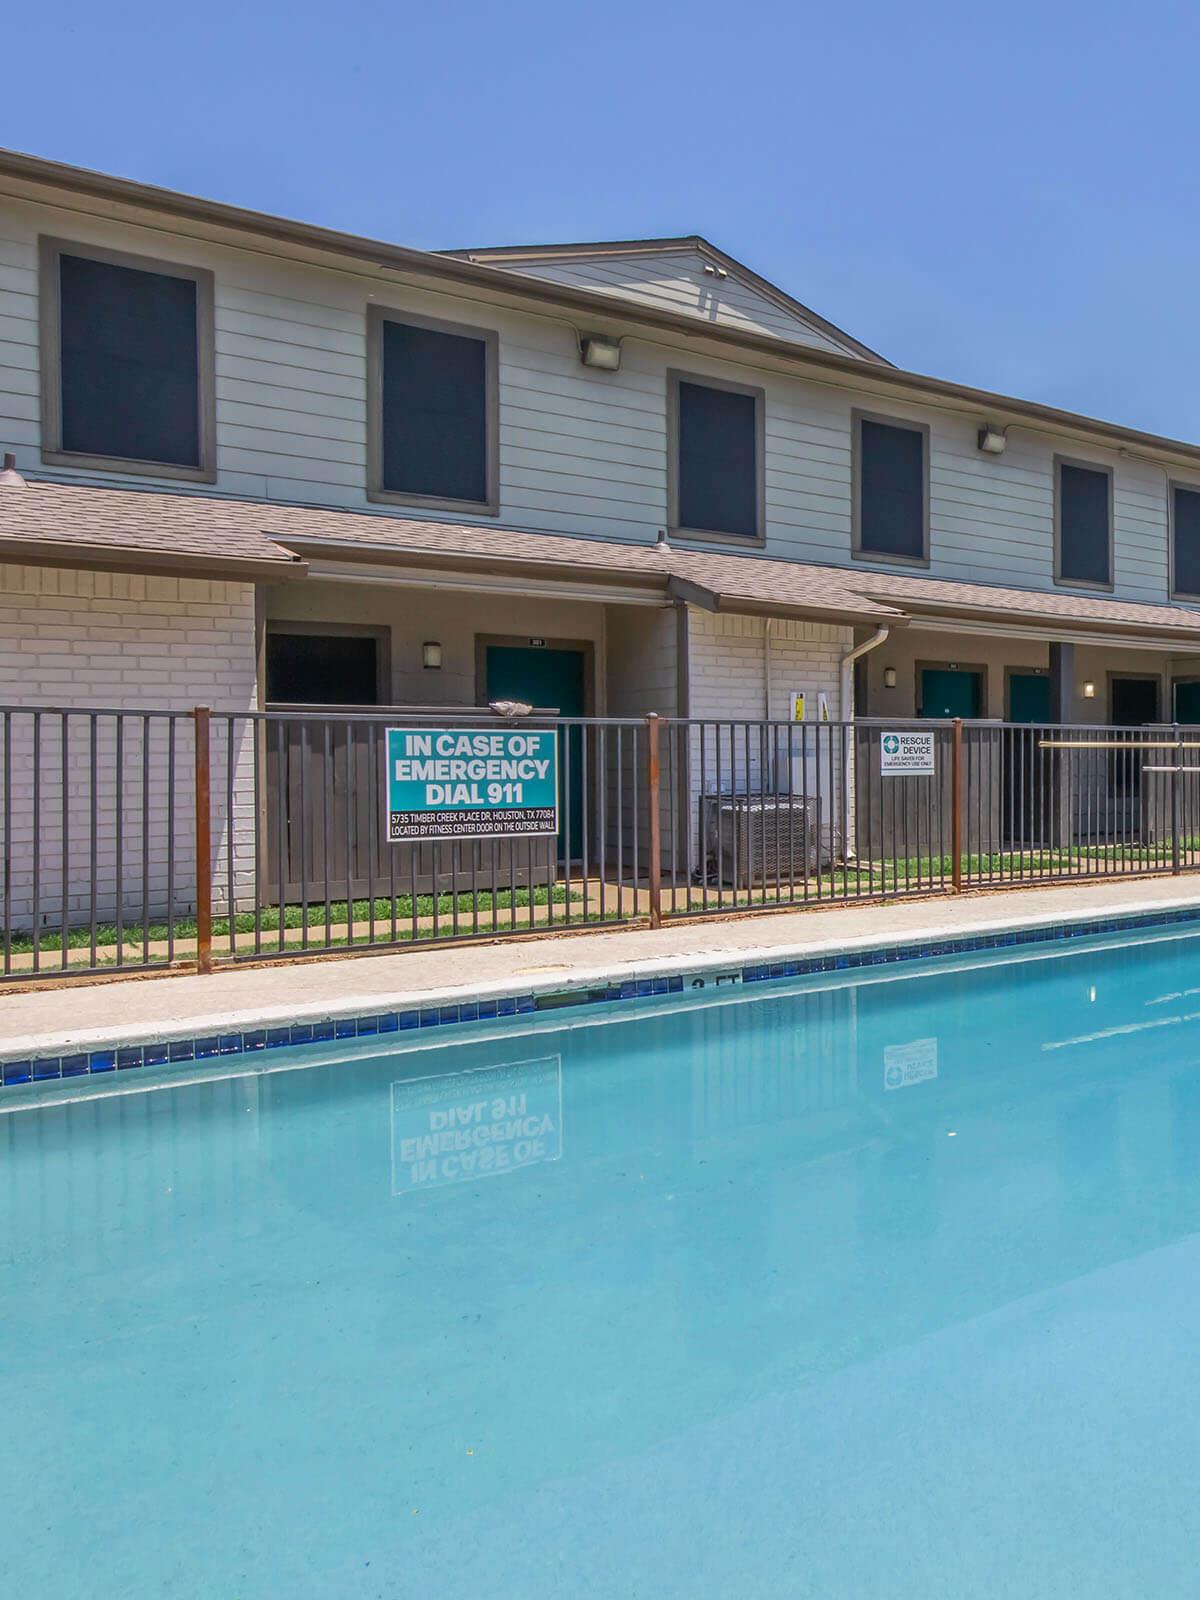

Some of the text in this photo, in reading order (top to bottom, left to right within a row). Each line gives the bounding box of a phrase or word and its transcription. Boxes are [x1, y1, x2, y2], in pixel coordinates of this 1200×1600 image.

[405, 735, 540, 757] IN CASE OF
[900, 736, 931, 745] RESCUE
[903, 746, 931, 754] DEVICE
[395, 759, 550, 781] EMERGENCY
[426, 783, 523, 805] DIAL 911
[391, 813, 409, 824] 5735
[410, 813, 436, 824] TIMBER
[437, 812, 458, 823] CREEK
[459, 811, 480, 822] PLACE
[526, 810, 535, 819] TX
[535, 810, 555, 819] 77084
[391, 821, 555, 836] LOCATED BY FITNESS CENTER DOOR ON THE OUTSIDE WALL
